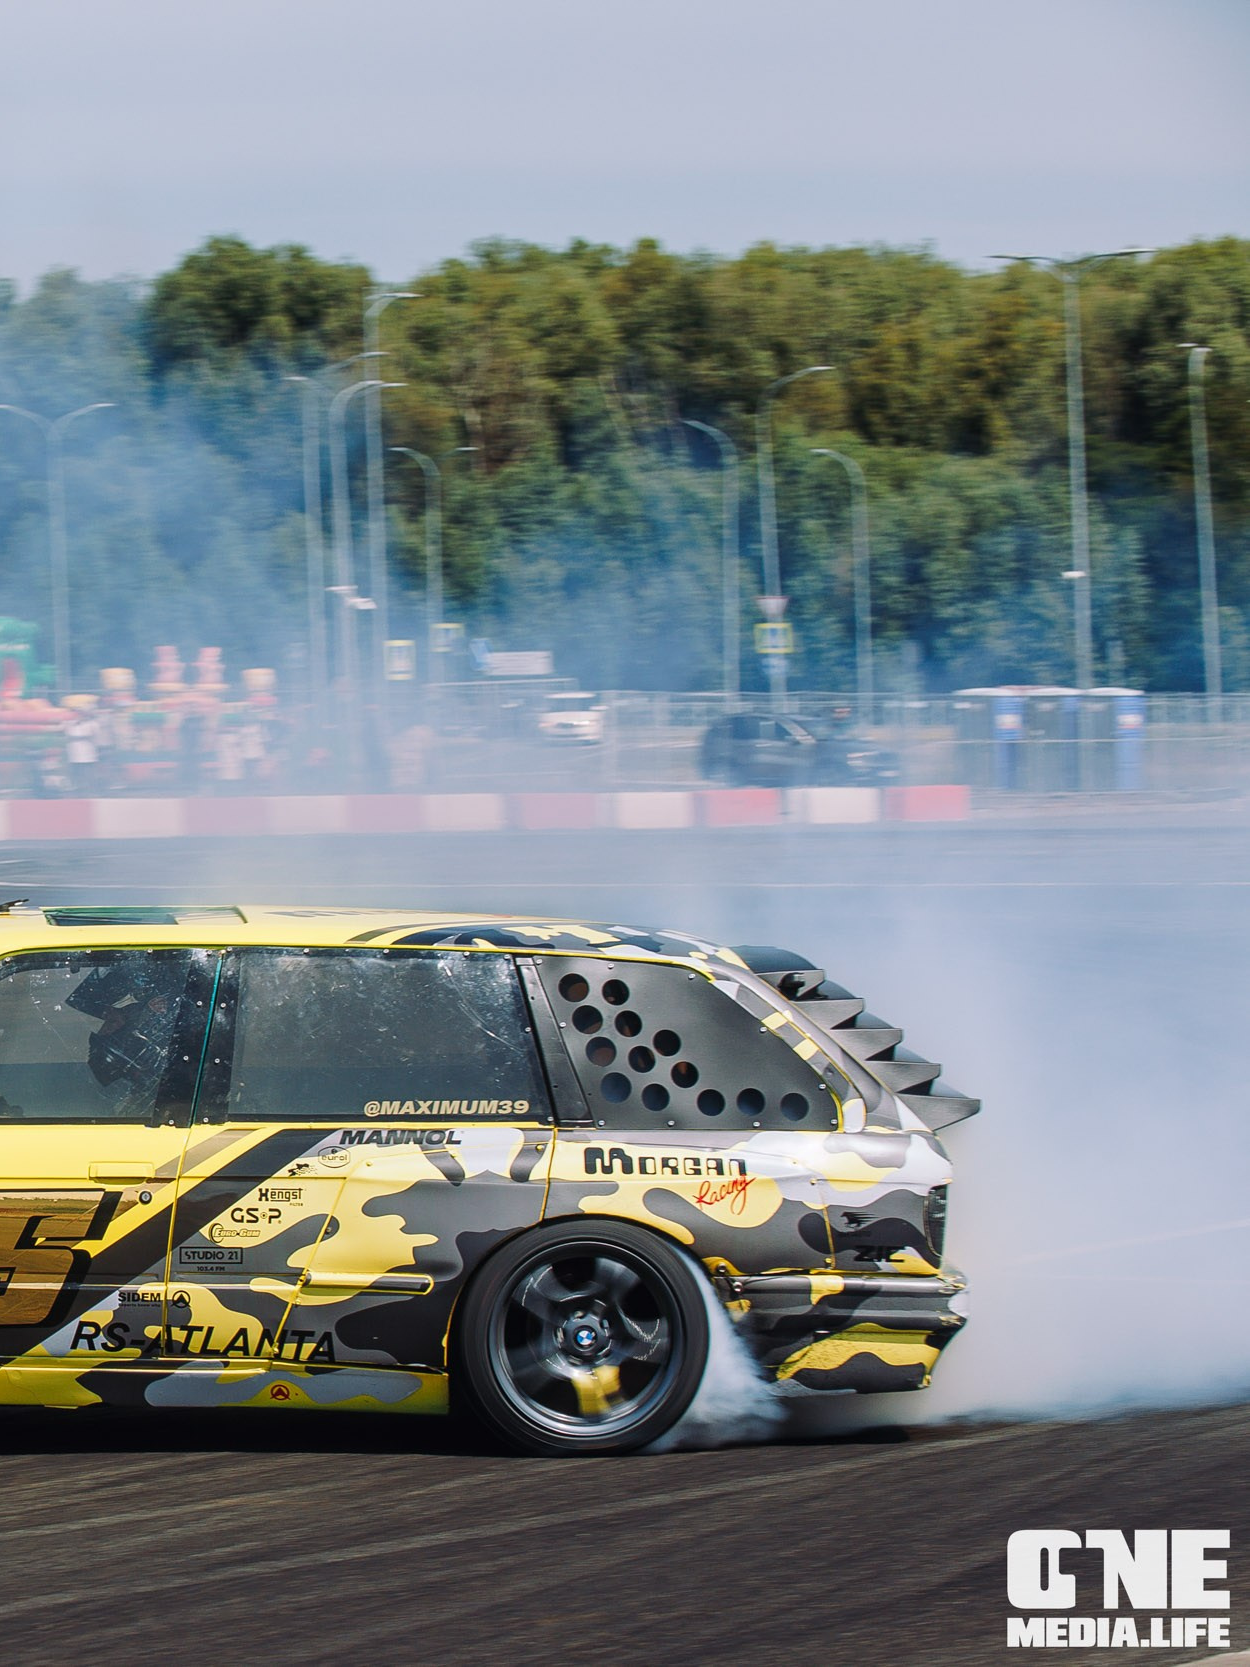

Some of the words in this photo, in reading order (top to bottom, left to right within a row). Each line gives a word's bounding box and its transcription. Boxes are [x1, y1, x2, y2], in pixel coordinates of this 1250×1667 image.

[364, 1100, 530, 1117] @MAXIMUM39
[340, 1130, 462, 1145] MANNOL
[258, 1187, 304, 1202] Hengst
[693, 1174, 757, 1215] Racing
[184, 1250, 225, 1260] STUDIO
[228, 1250, 238, 1260] 21
[118, 1292, 161, 1302] SIDEM
[70, 1320, 336, 1363] RS-ATLANTA
